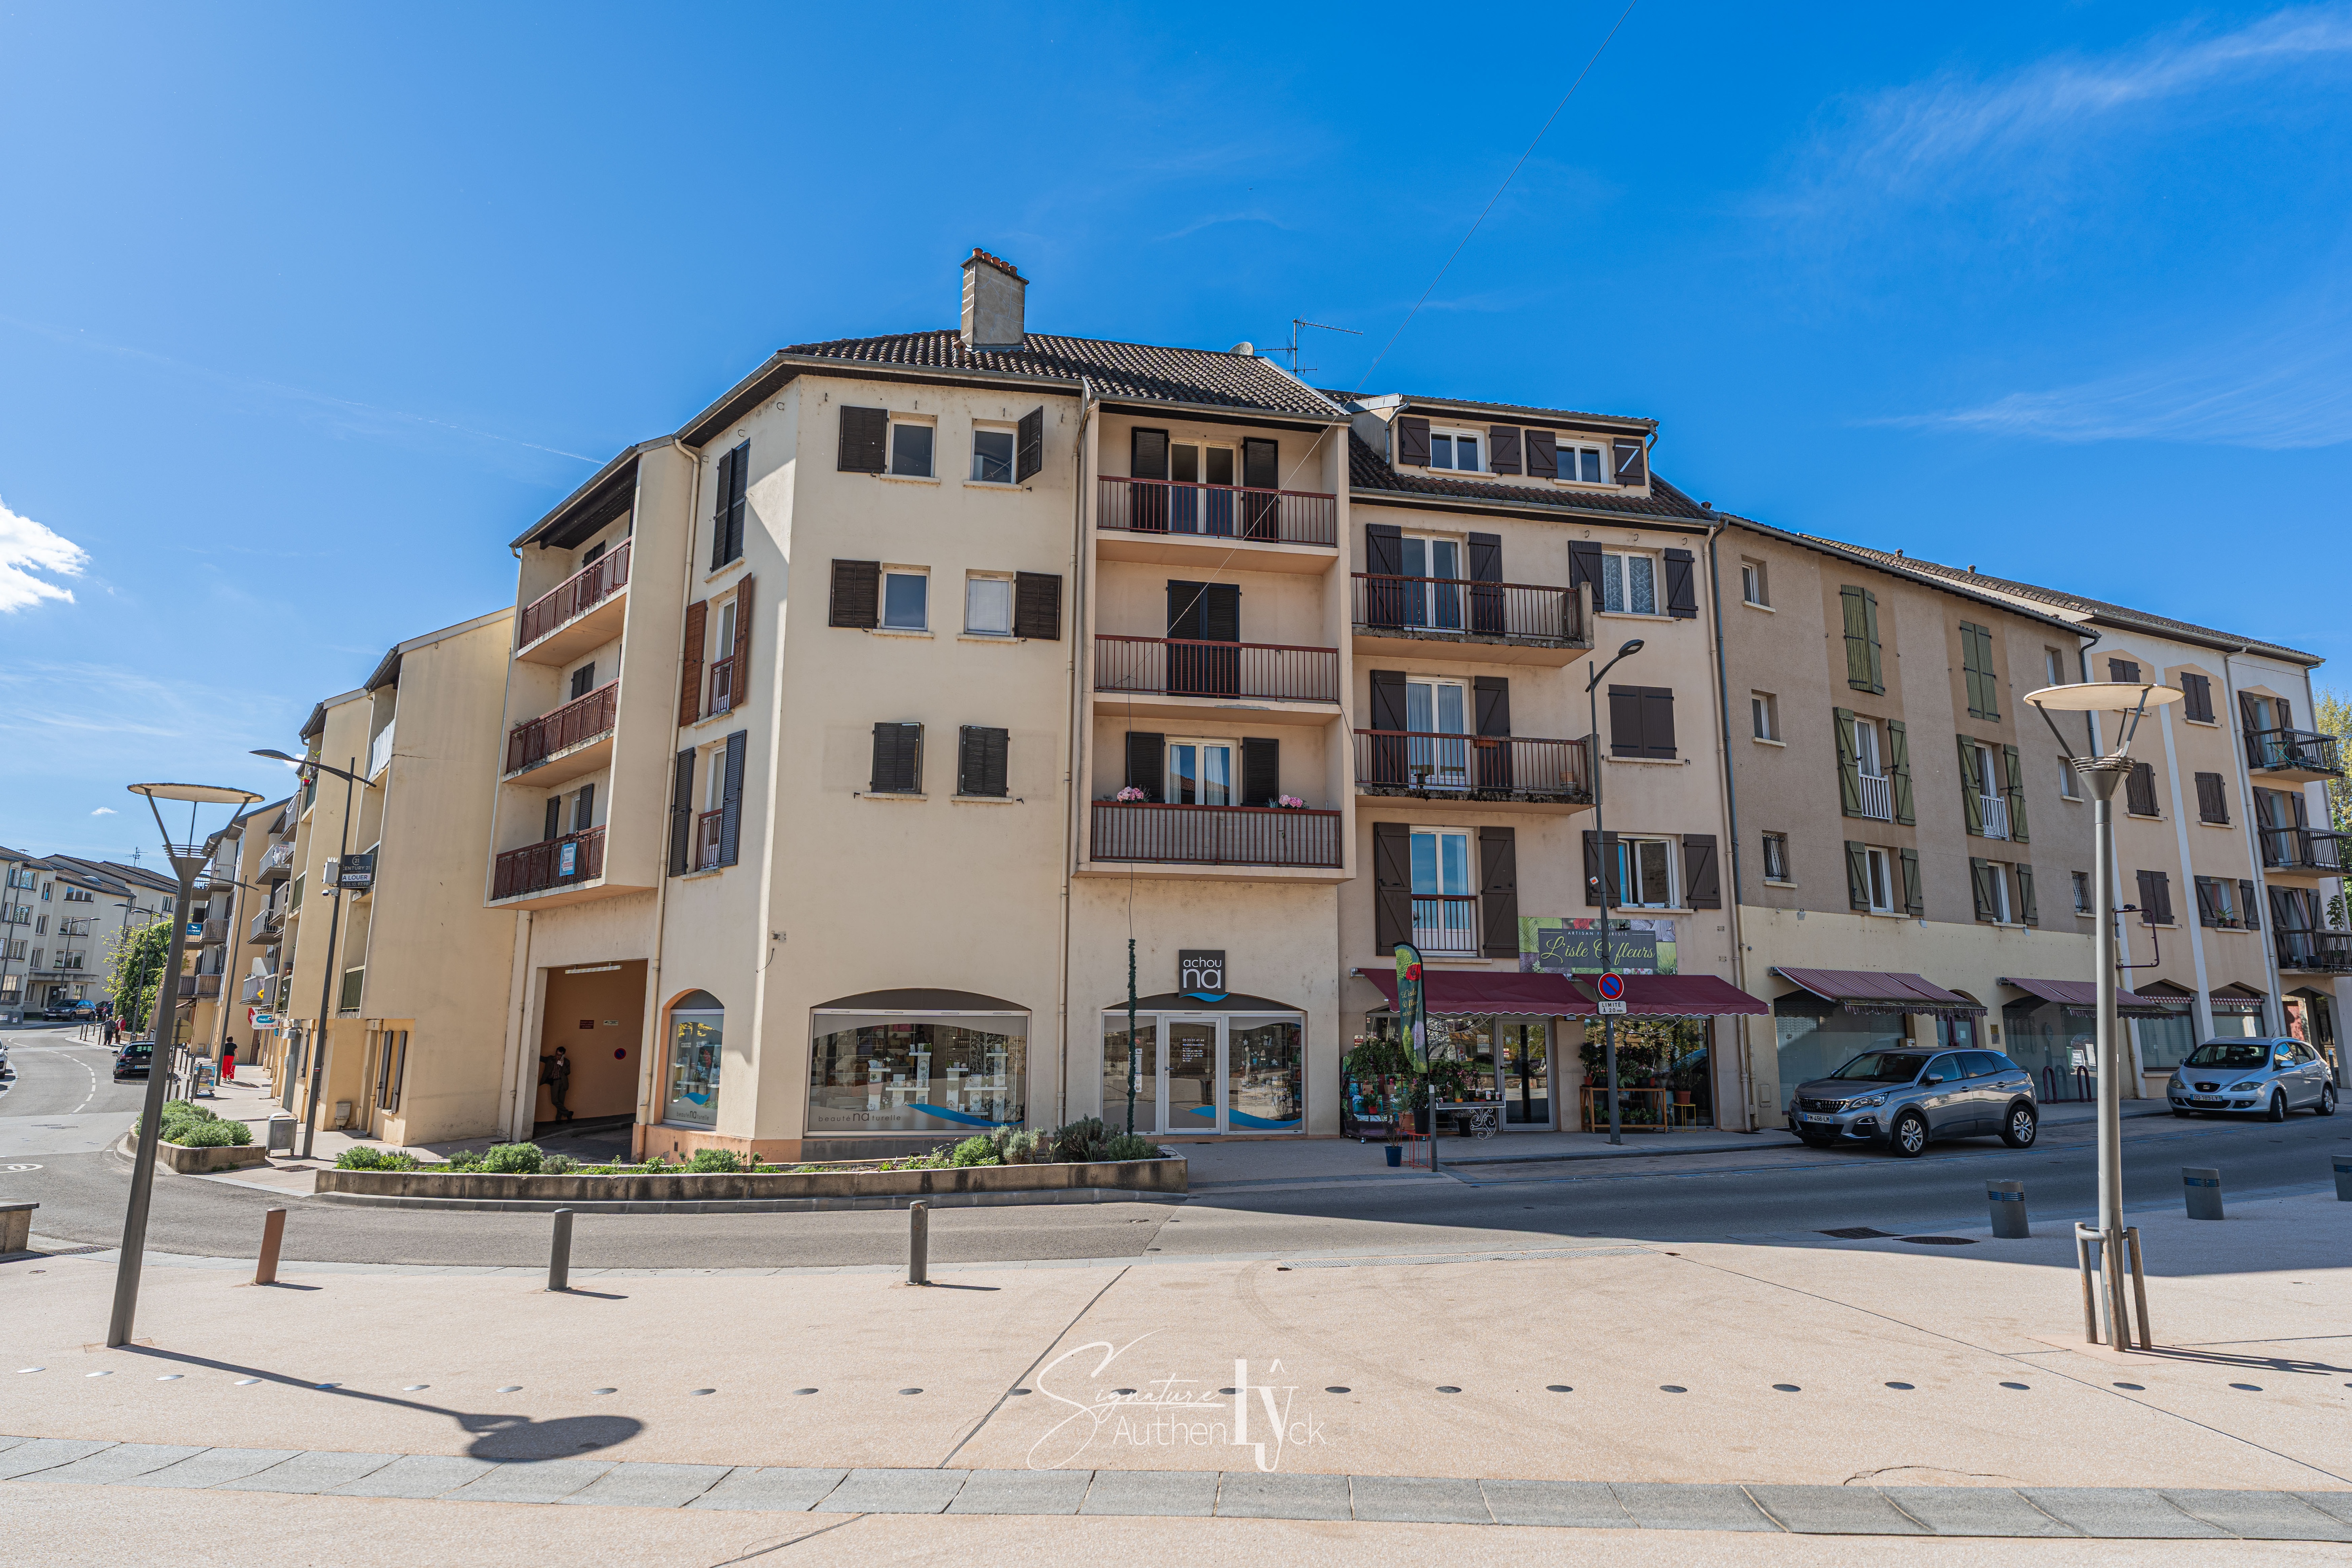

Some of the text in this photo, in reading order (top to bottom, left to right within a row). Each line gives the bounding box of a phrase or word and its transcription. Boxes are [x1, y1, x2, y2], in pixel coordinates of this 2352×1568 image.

[1541, 936, 1589, 964] L'isle
[1614, 942, 1655, 966] fleurs
[1183, 957, 1221, 967] achou
[1183, 969, 1221, 989] na
